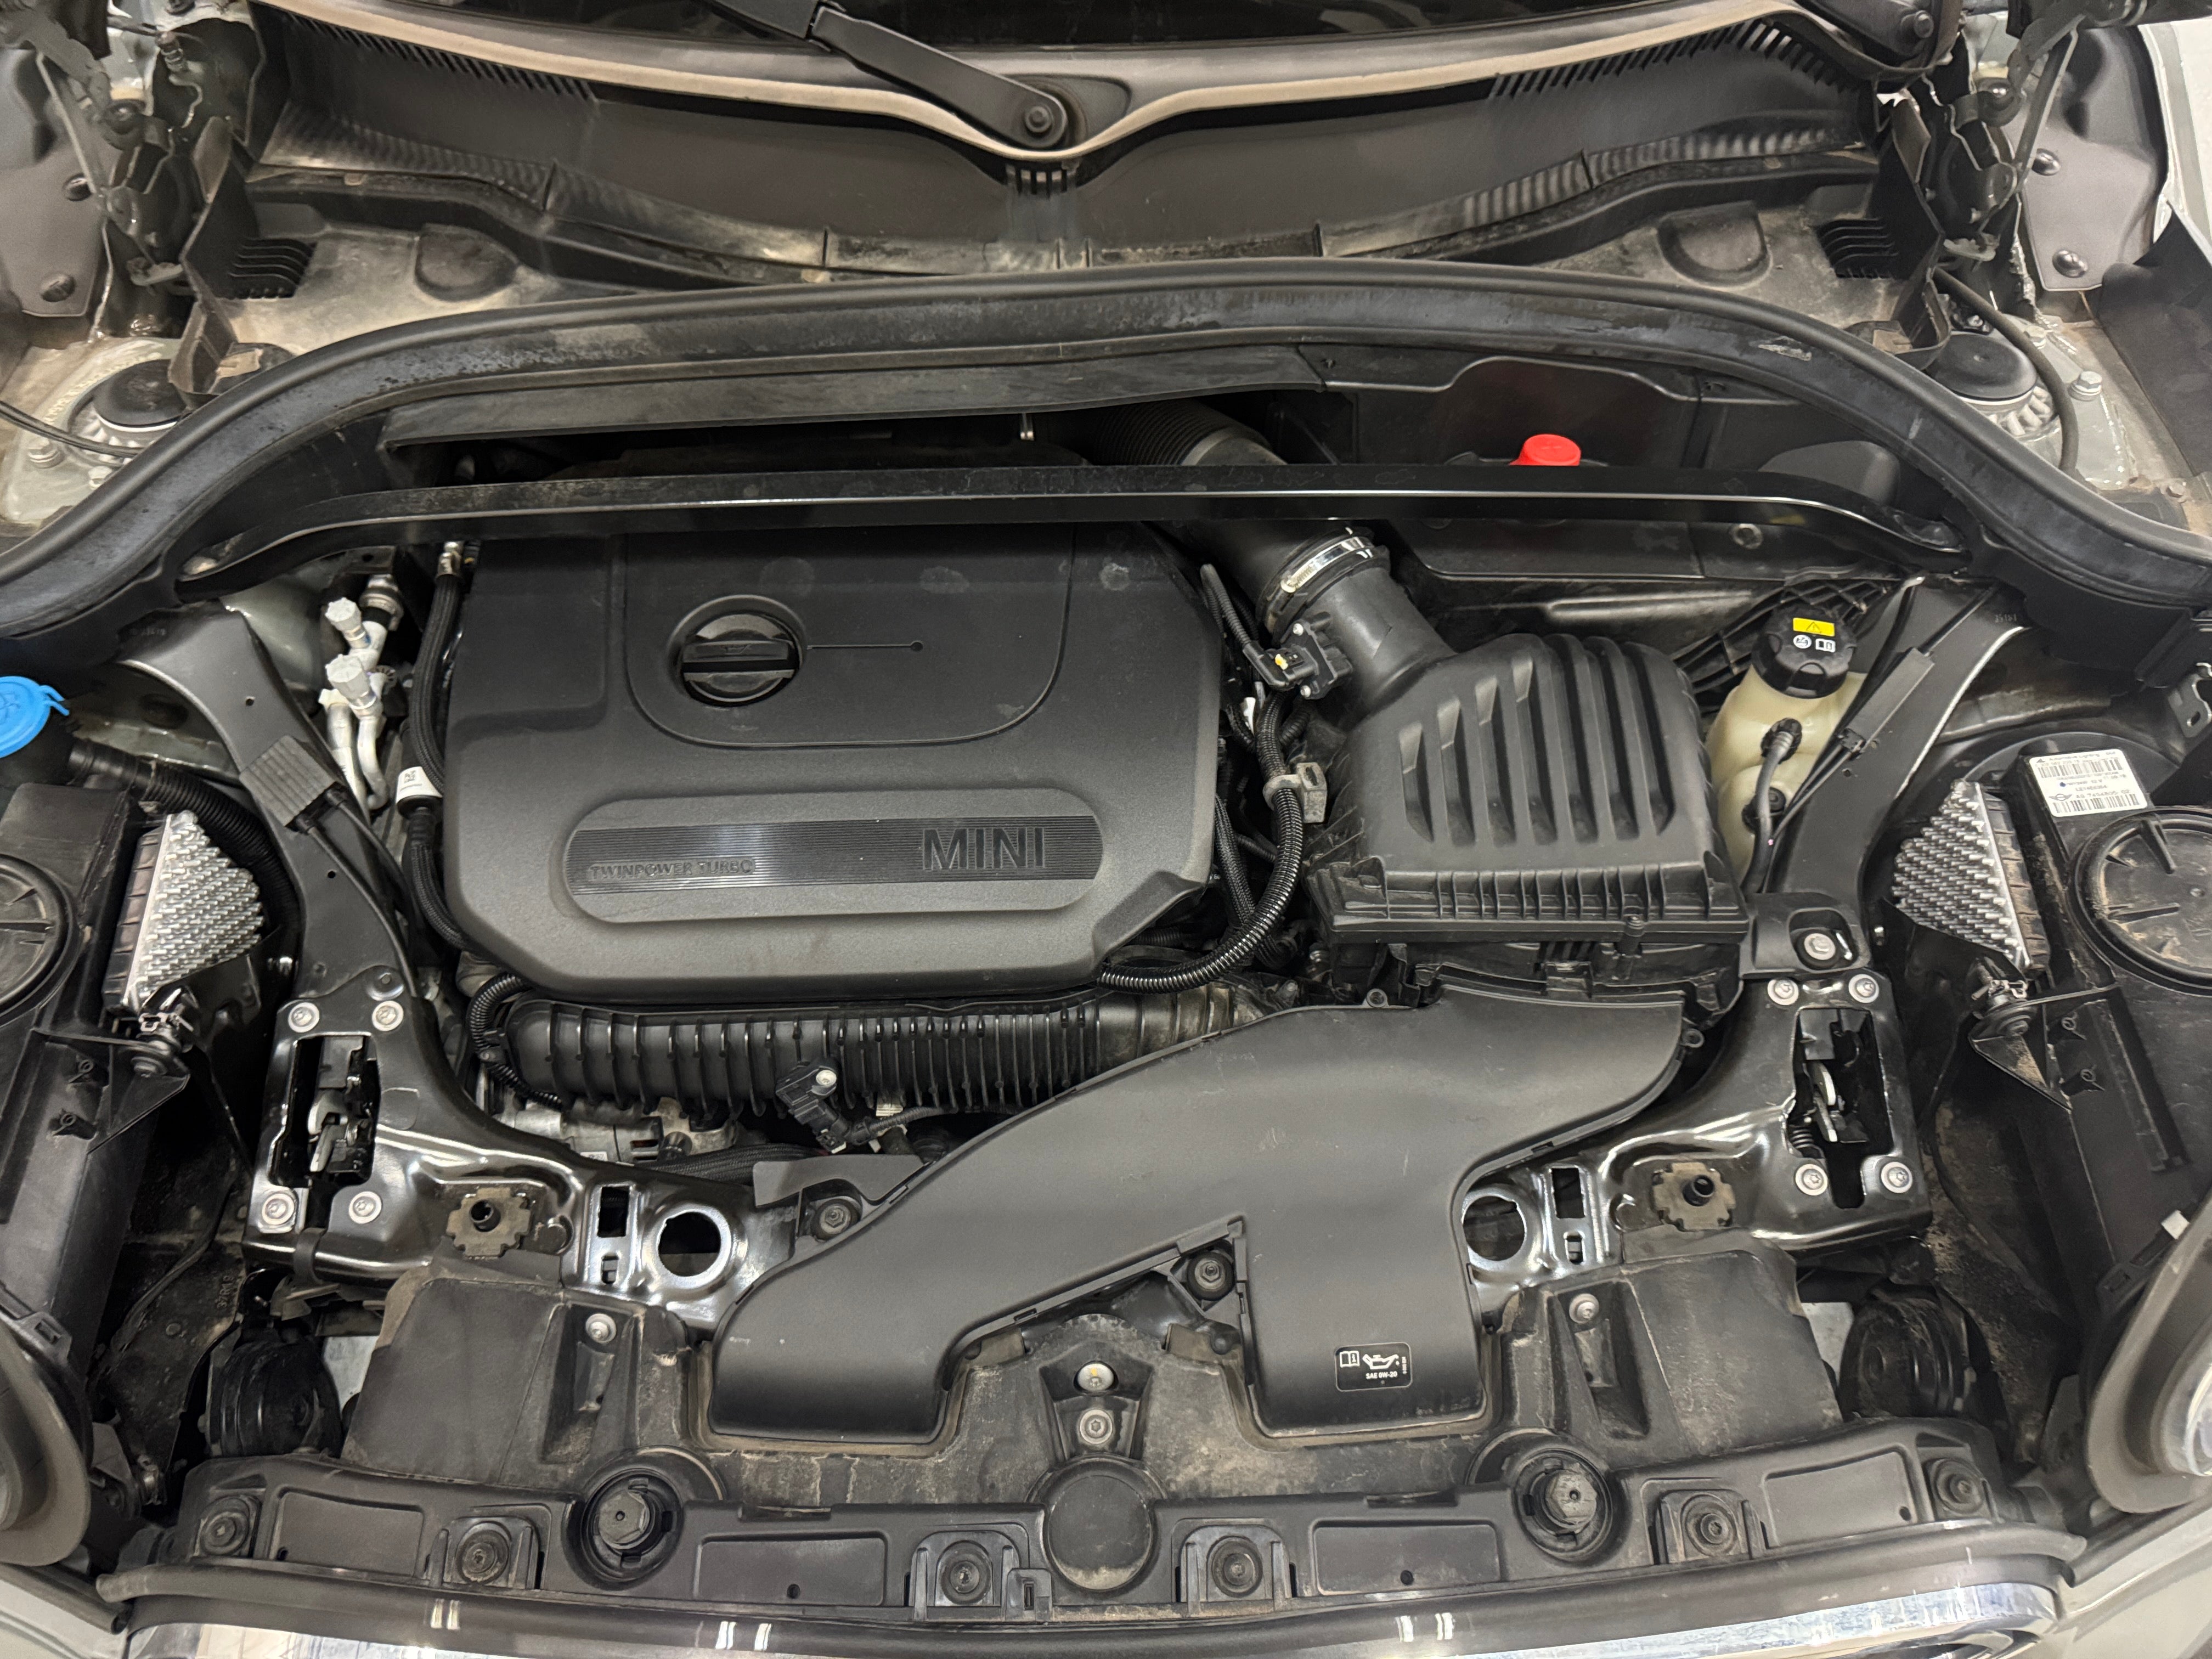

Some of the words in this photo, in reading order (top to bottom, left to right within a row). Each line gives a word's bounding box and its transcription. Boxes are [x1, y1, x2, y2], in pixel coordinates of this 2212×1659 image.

[922, 827, 1046, 871] MINI
[590, 862, 692, 879] TWINPOWER
[697, 860, 752, 874] TURBO
